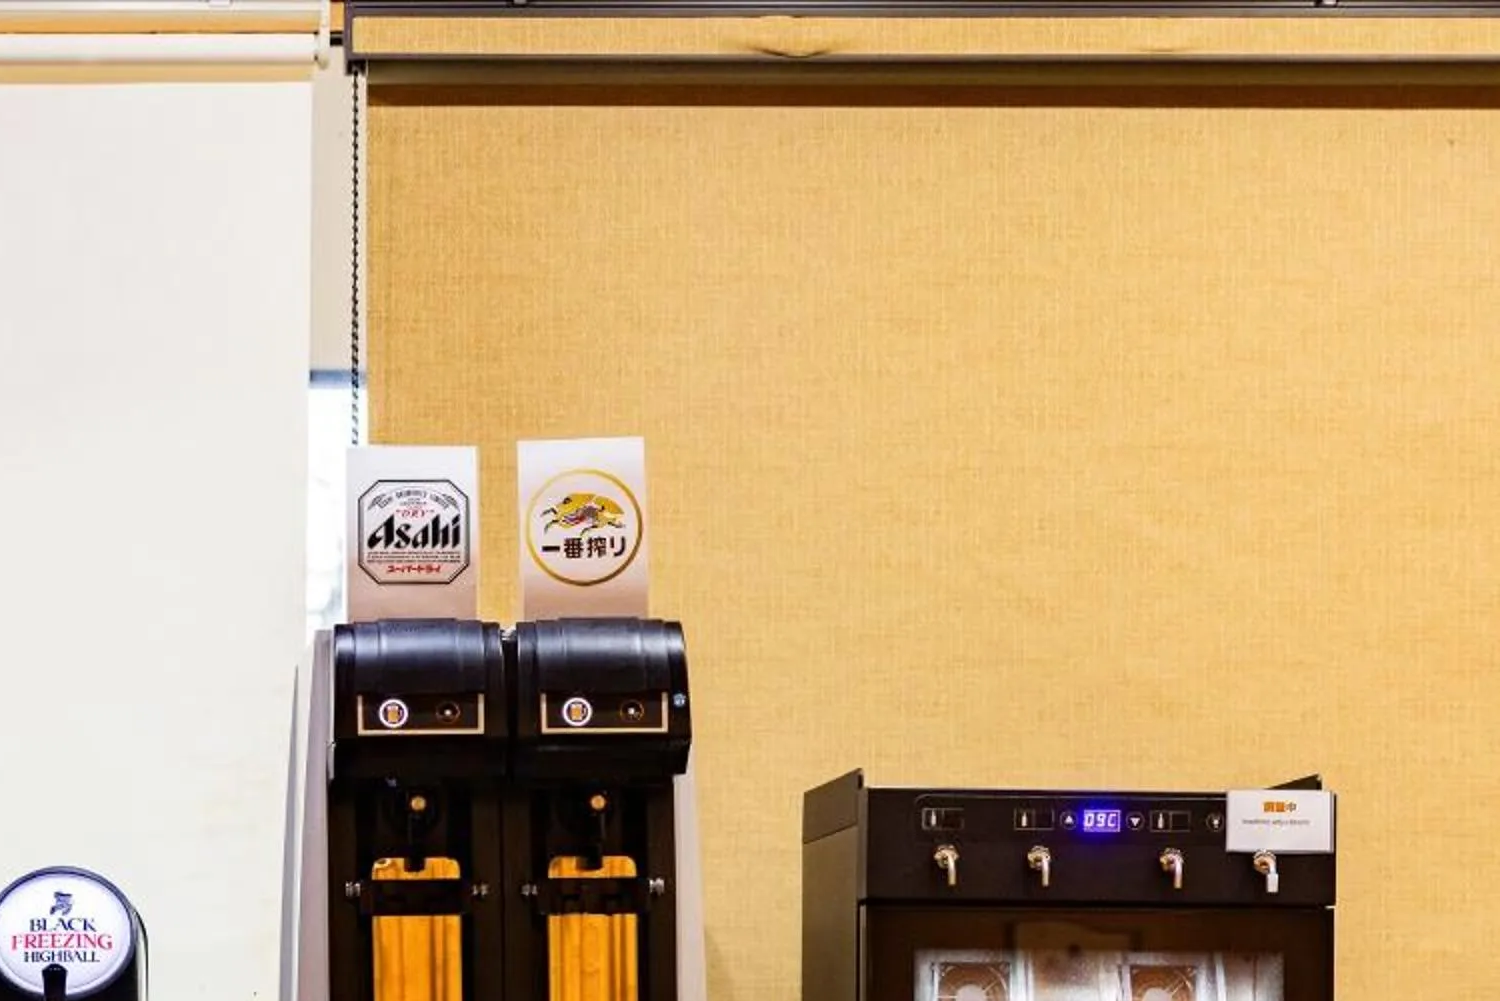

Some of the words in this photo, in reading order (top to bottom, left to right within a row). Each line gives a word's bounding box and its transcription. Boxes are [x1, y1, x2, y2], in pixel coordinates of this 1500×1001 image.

[367, 513, 461, 549] Asahi
[541, 536, 627, 559] 一番搾り
[29, 917, 97, 932] BLACK
[11, 933, 113, 950] FREEZING
[24, 951, 101, 963] HIGHBALL
